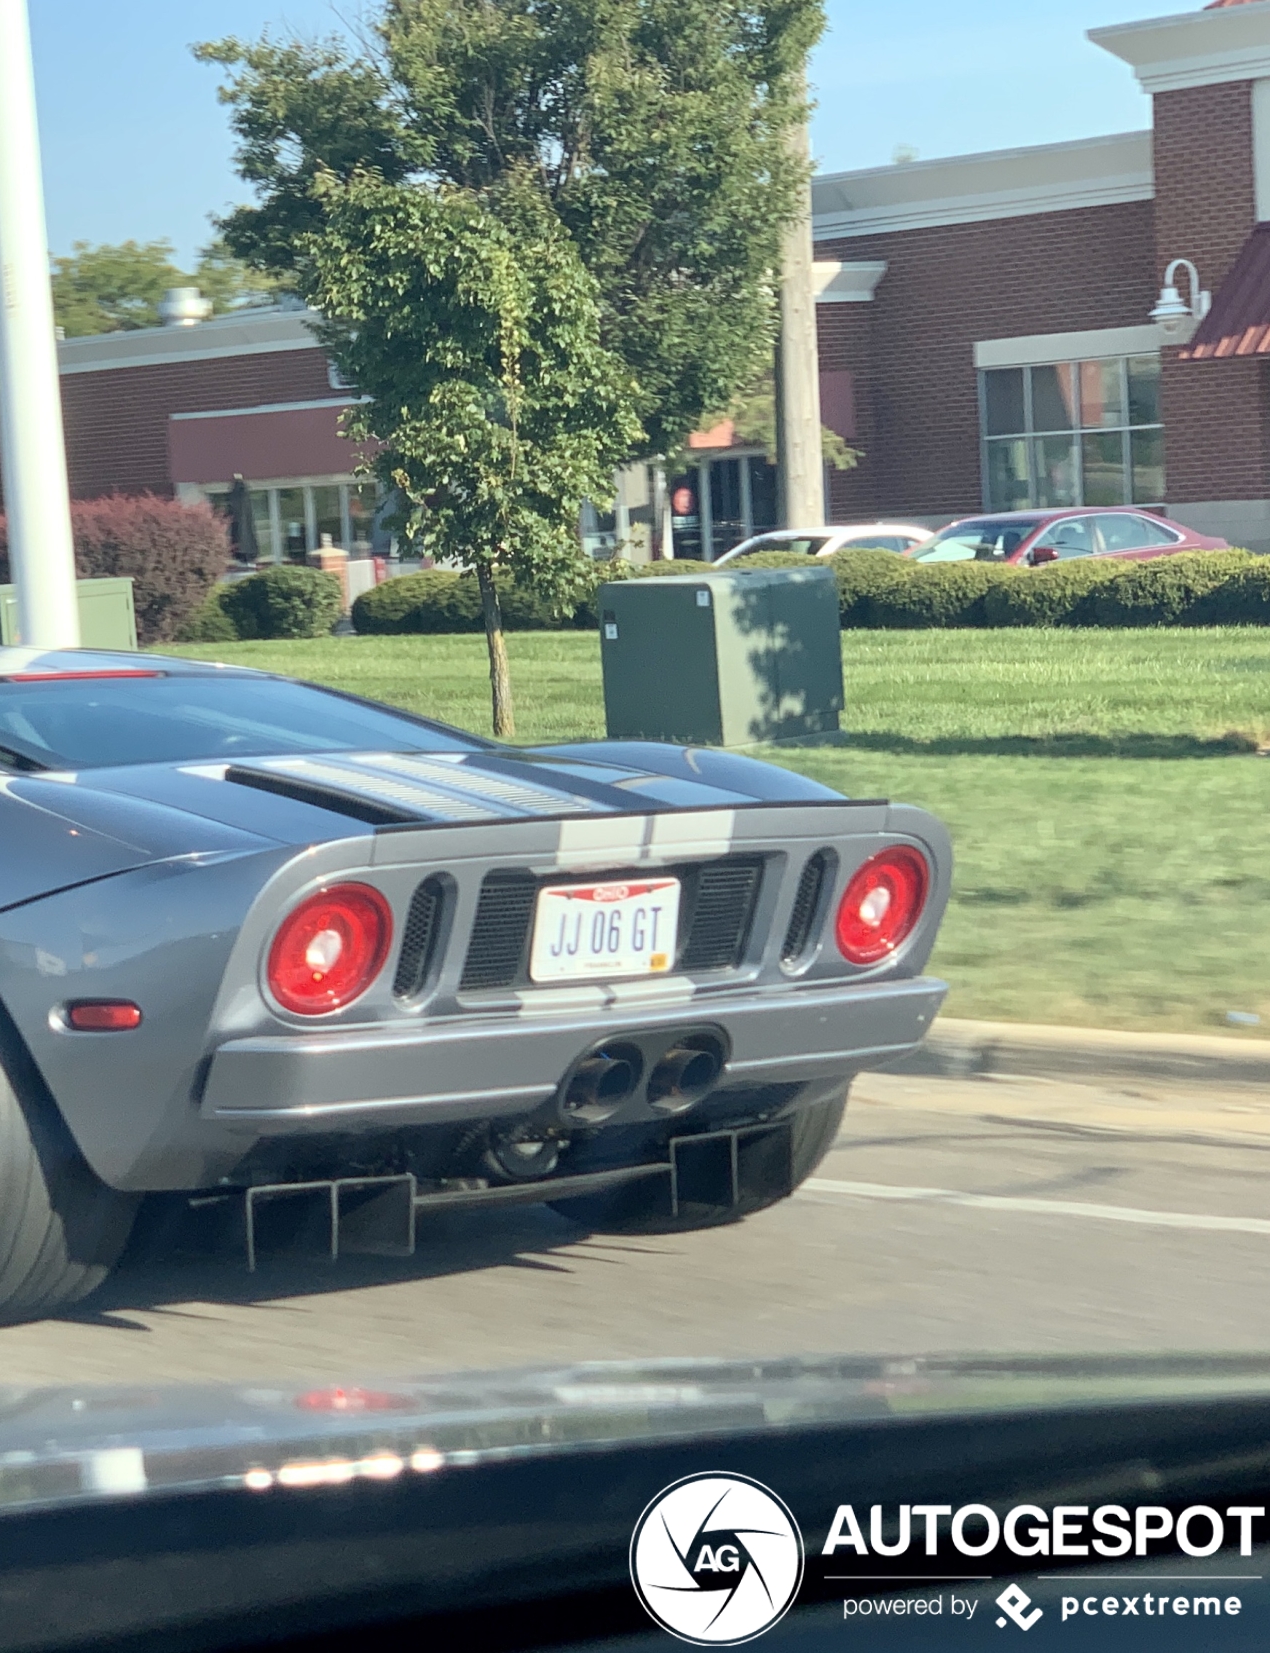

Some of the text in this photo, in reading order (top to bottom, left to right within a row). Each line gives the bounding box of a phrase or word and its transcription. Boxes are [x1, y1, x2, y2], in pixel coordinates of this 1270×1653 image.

[550, 906, 662, 957] JJ 06 GT
